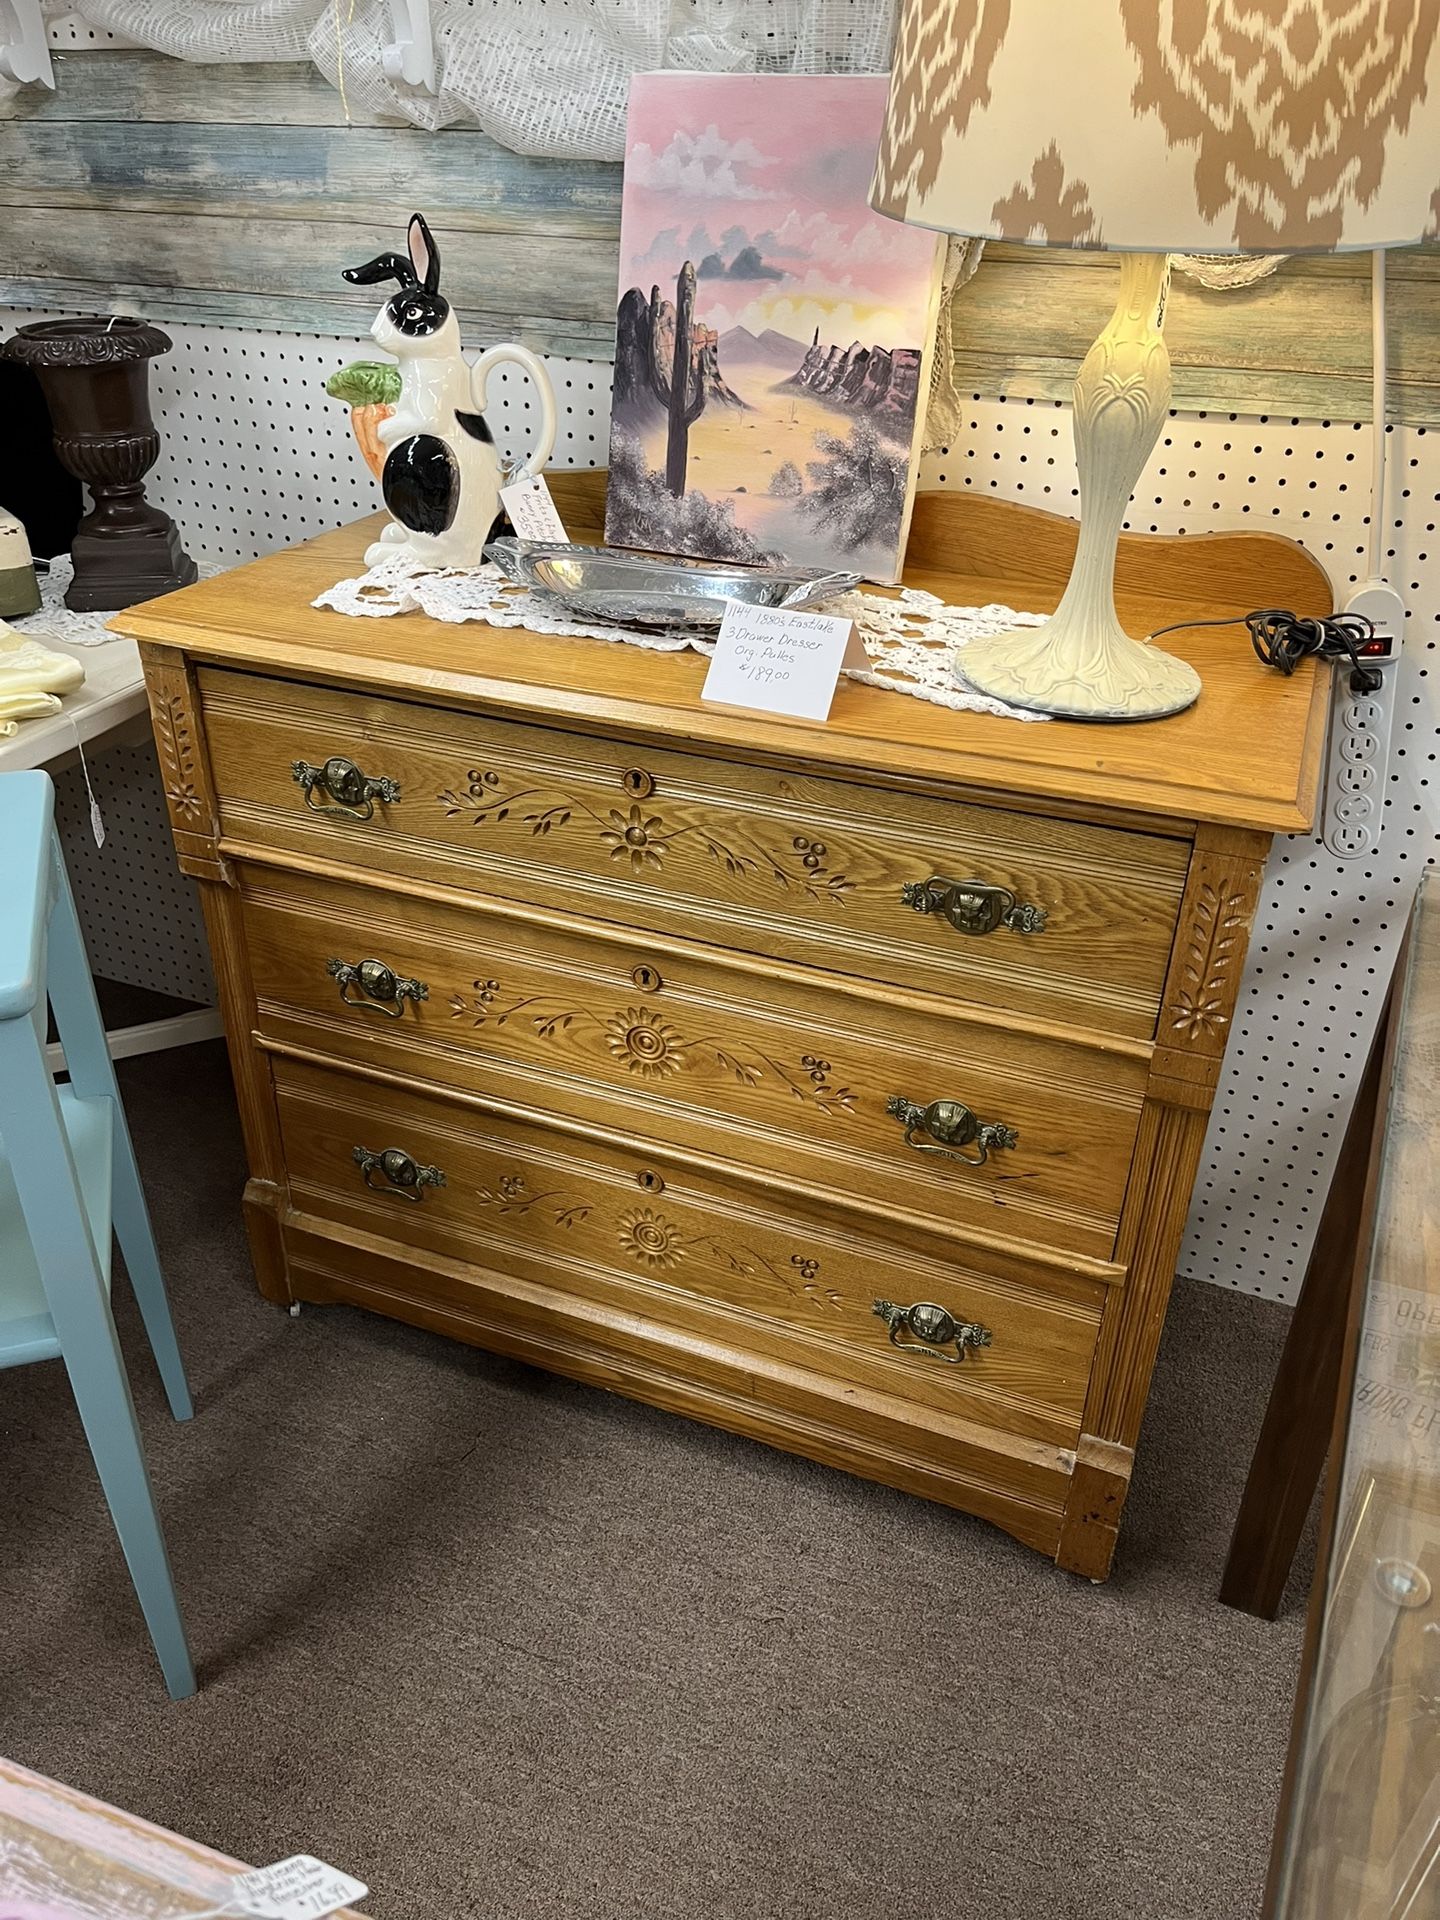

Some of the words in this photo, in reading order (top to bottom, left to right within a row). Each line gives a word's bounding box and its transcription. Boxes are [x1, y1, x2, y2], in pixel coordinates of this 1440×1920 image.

[728, 604, 753, 618] 1144
[788, 616, 835, 634] Eastlake
[778, 633, 824, 650] Dresser
